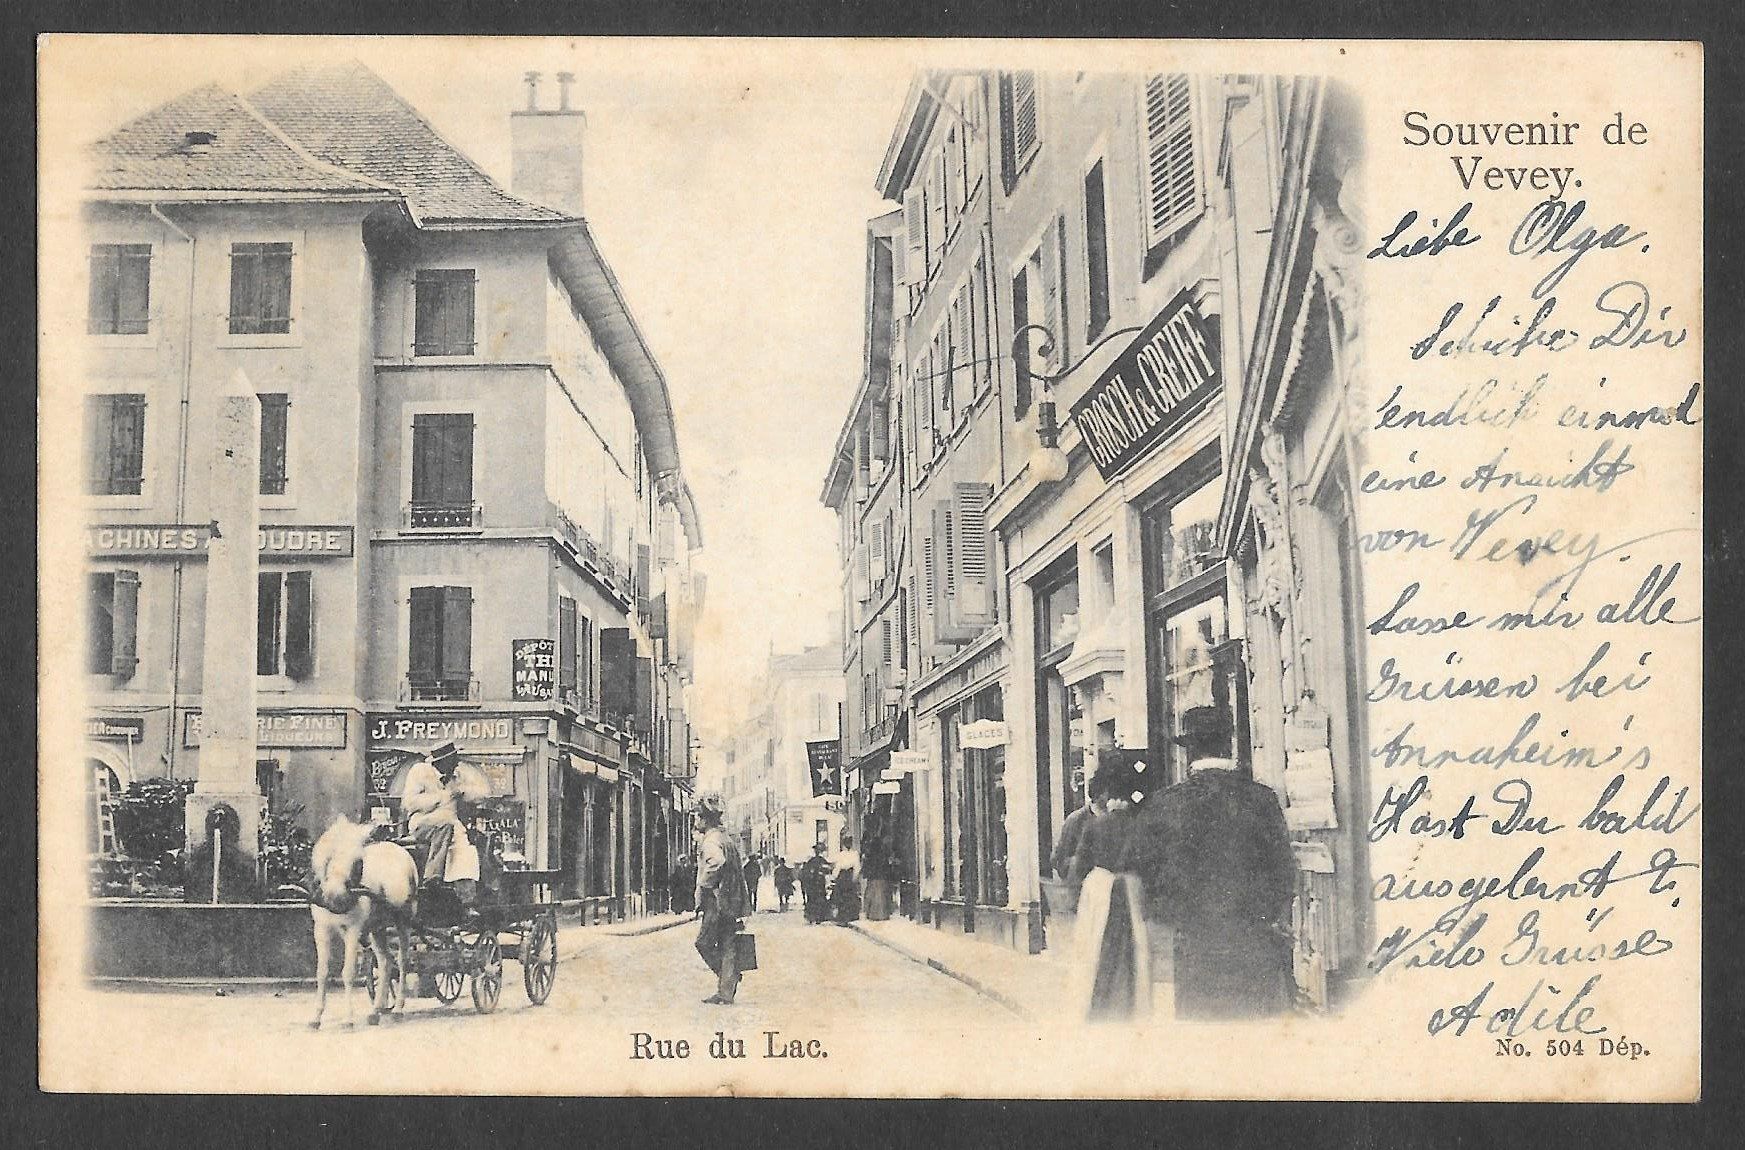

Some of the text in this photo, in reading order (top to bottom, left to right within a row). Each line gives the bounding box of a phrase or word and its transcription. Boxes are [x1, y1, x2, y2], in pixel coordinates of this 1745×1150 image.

[1589, 281, 1687, 349] Dir
[1136, 303, 1215, 414] GREIFF
[1135, 388, 1161, 426] &
[1361, 439, 1635, 493] eine Ansicht
[1357, 529, 1446, 553] von
[1486, 592, 1583, 630] mir
[1597, 562, 1700, 625] alle
[1555, 641, 1651, 702] bei
[371, 719, 508, 740] J. FREYMOND
[1368, 774, 1700, 842] Hast Du bald
